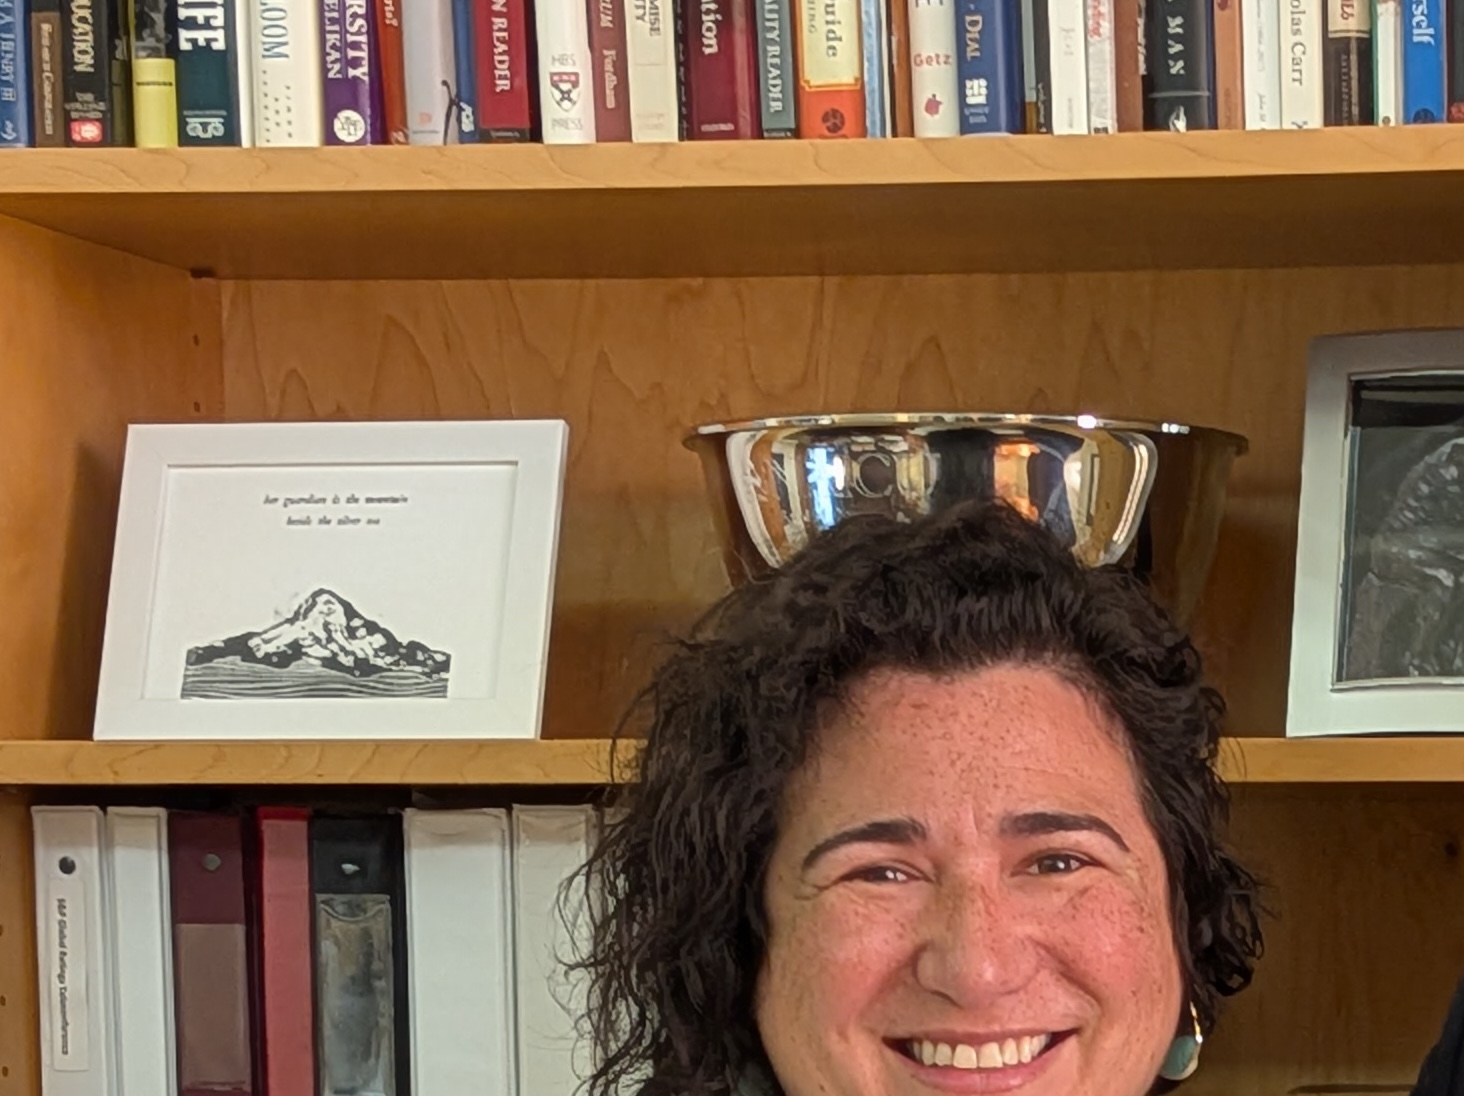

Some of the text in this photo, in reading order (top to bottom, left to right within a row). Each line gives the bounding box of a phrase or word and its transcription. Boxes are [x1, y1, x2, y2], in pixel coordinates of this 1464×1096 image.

[491, 17, 511, 92] READER
[701, 0, 722, 56] tion
[965, 14, 983, 62] DIAL
[1167, 15, 1186, 76] MAN
[603, 50, 617, 109] Fordham
[766, 45, 784, 113] READER
[912, 51, 952, 67] Getz
[1290, 42, 1307, 86] Carr
[551, 118, 583, 131] PRESS
